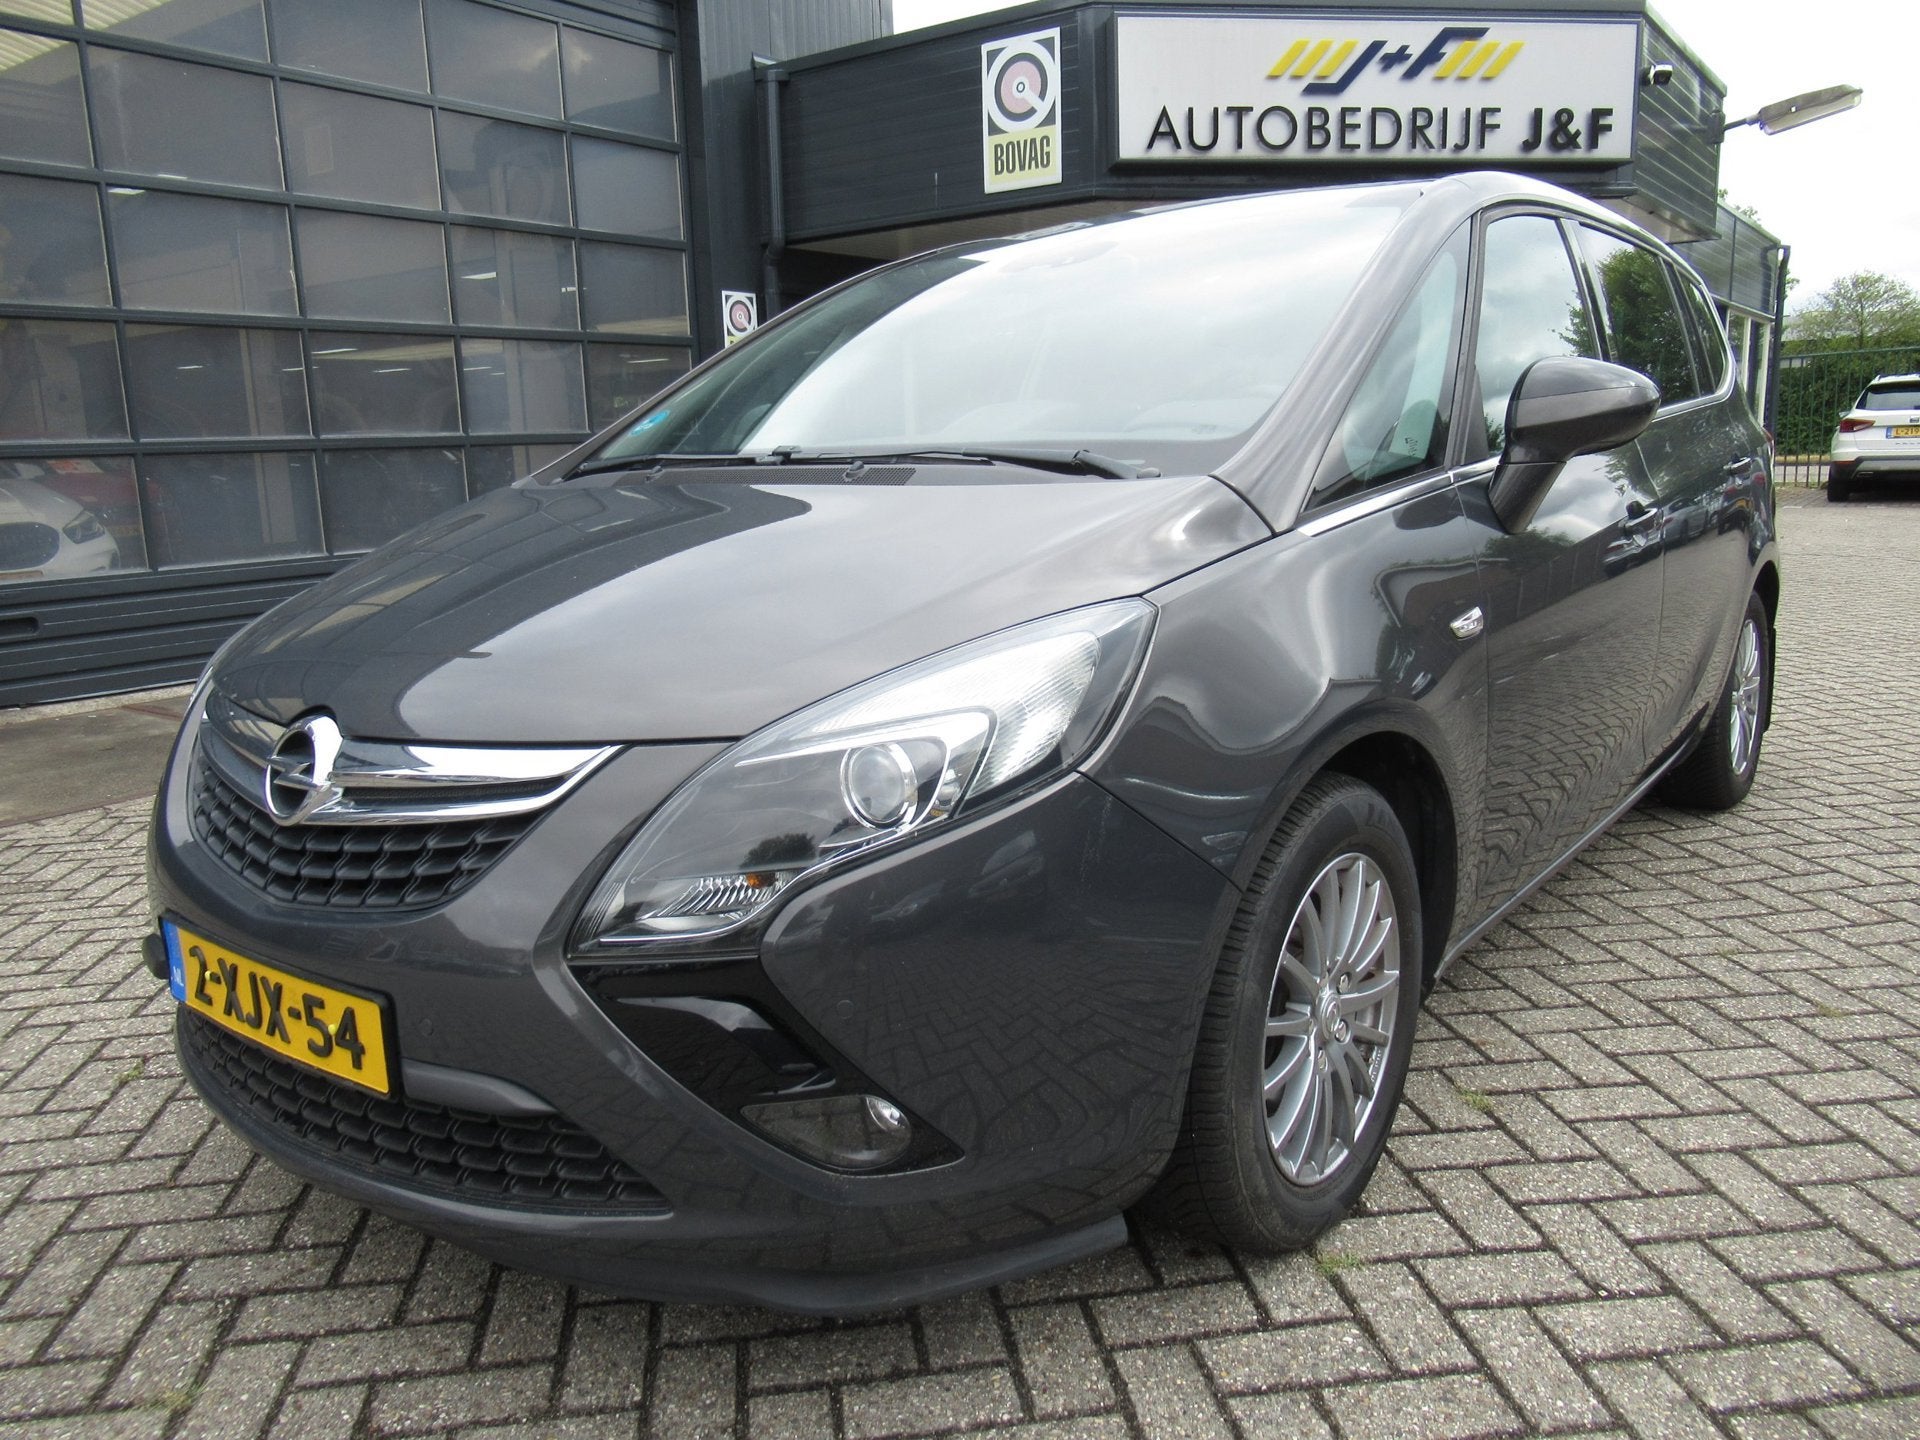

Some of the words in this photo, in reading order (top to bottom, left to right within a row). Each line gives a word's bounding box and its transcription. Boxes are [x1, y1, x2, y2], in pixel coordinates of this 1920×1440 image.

[1146, 105, 1502, 152] AUTOBEDRIJF
[1522, 107, 1614, 152] J&F
[994, 135, 1051, 176] BOVAG
[188, 944, 366, 1070] 2-XJX-54
